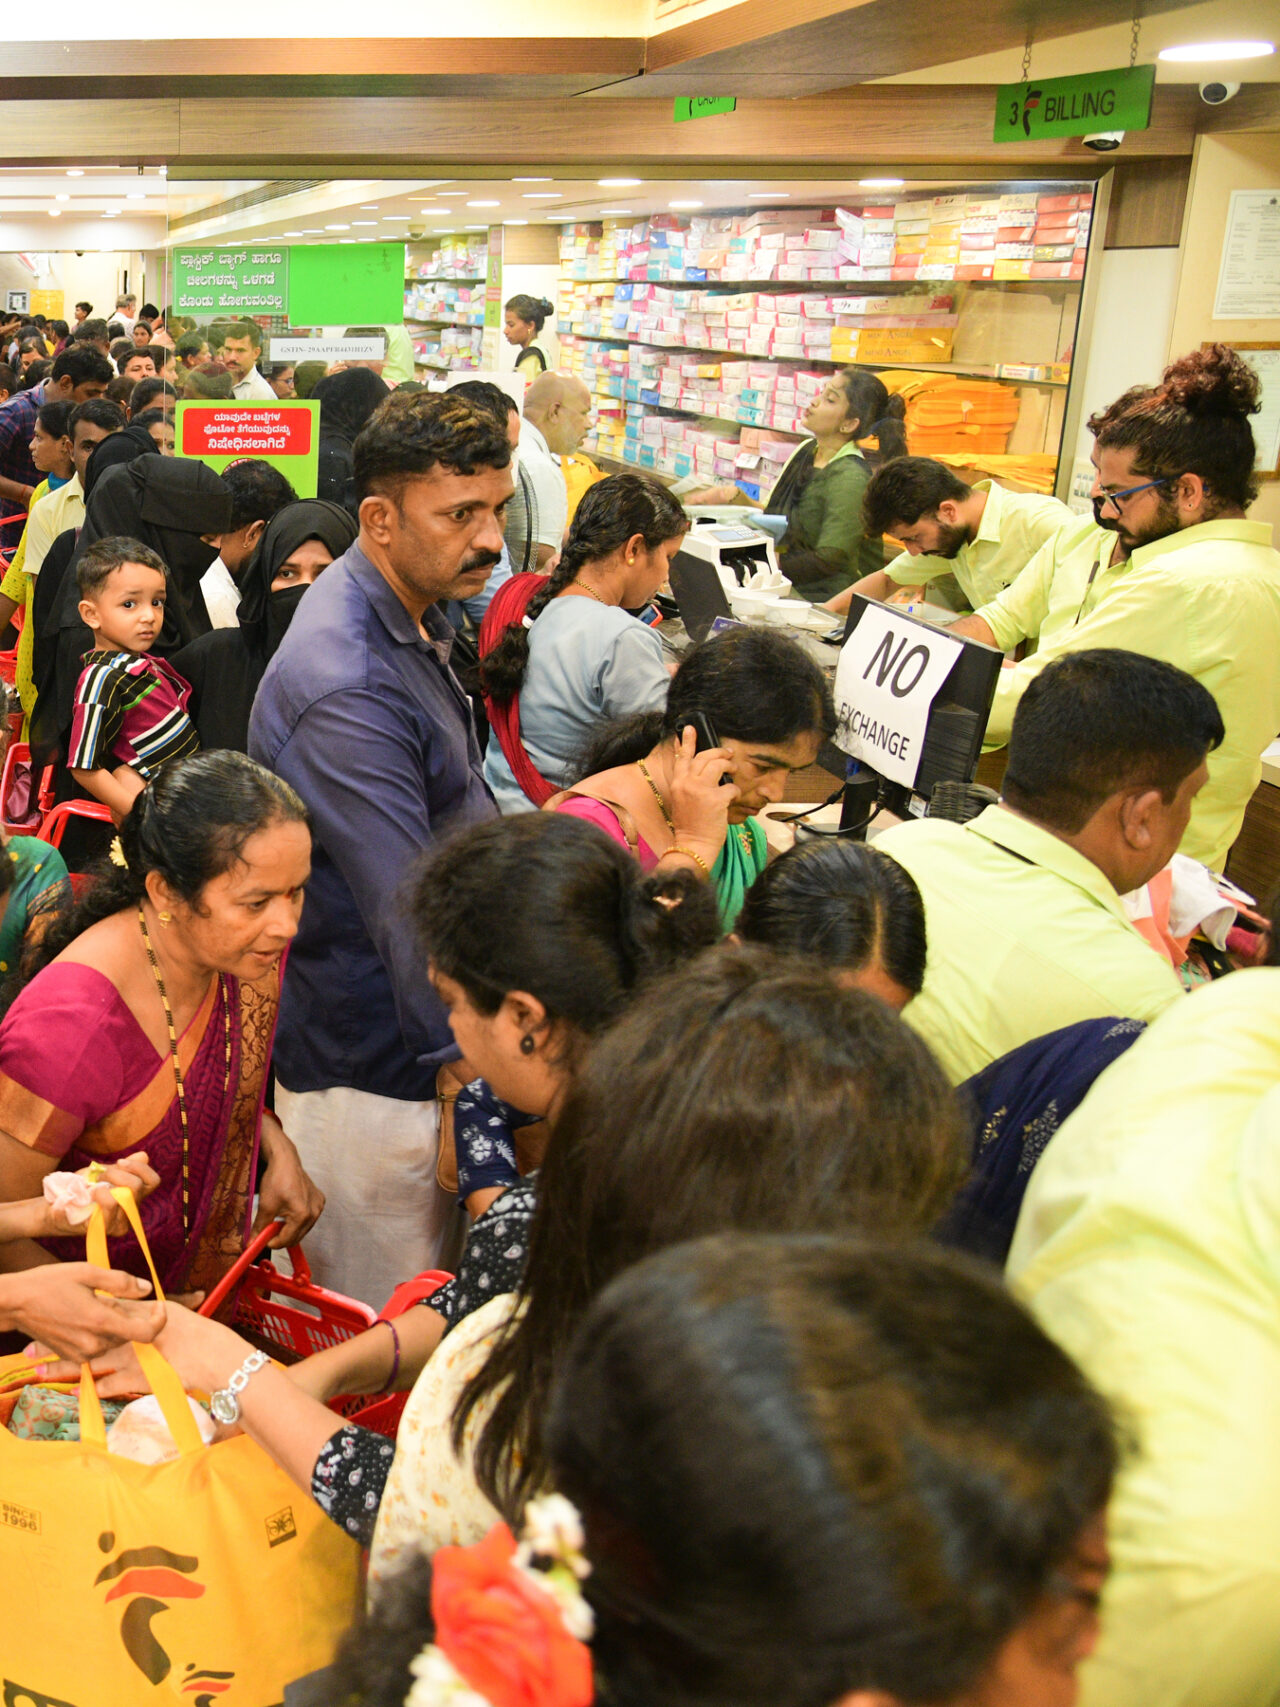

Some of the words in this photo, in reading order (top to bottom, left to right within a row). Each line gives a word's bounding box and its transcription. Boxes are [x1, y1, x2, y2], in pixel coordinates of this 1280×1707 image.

[1009, 101, 1019, 126] 3
[1044, 89, 1116, 122] BILLING
[252, 253, 282, 264] ಹಾಗೂ
[243, 272, 275, 285] ಒಳಗಡೆ
[179, 293, 214, 307] ಕೊಂಡು
[214, 412, 252, 423] ಯಾವುದೇ
[208, 437, 286, 451] ನಿಷೇಧಿಸಲಾಗಿದೆ
[862, 630, 931, 698] NO
[839, 702, 911, 761] EXCHANGE
[2, 1511, 38, 1531] 1996
